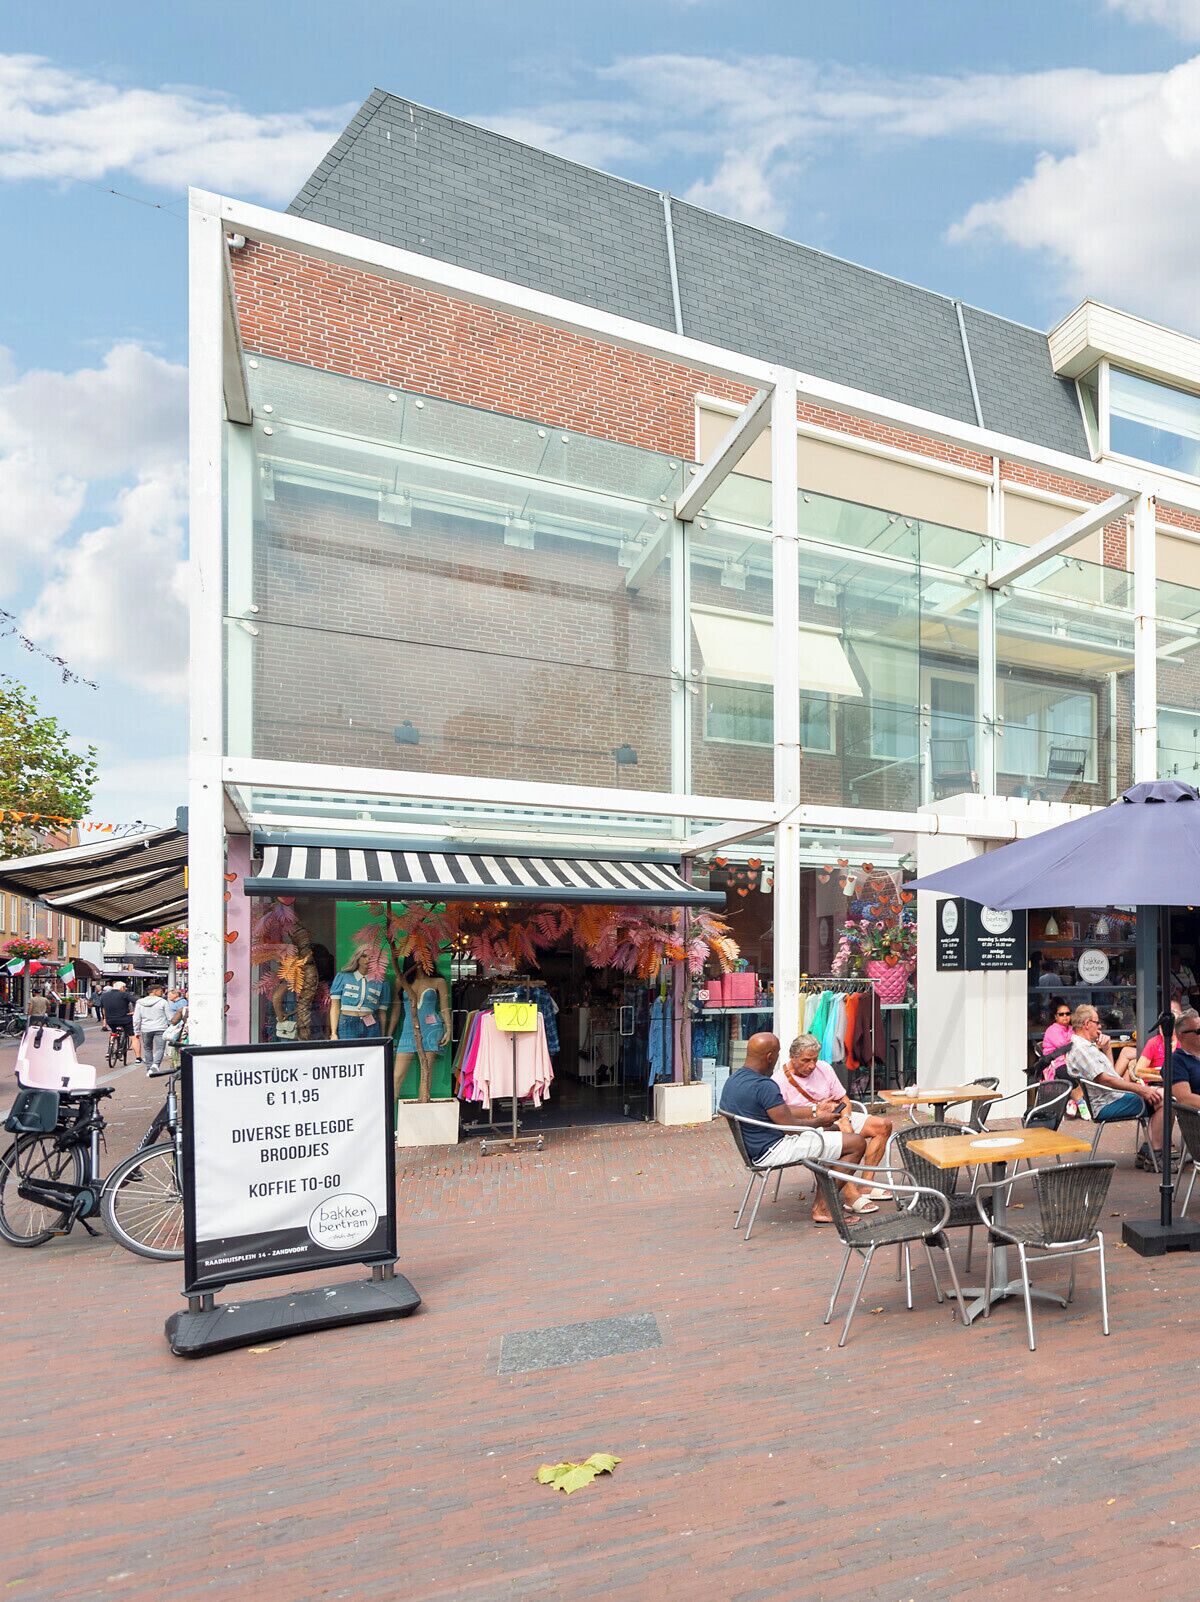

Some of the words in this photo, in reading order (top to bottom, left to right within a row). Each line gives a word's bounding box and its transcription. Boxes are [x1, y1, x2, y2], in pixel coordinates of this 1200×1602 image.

[1083, 957, 1104, 965] bakker
[506, 1004, 529, 1027] 20
[215, 1067, 299, 1088] FRÜHSTÜCK
[312, 1063, 365, 1081] ONTBIJT
[266, 1091, 275, 1106] €
[281, 1088, 320, 1105] 11,95
[232, 1124, 291, 1144] DIVERSE
[295, 1118, 354, 1138] BELEGDE
[260, 1142, 329, 1163] BROODJES
[248, 1179, 297, 1198] KOFFIE
[300, 1174, 341, 1192] TO-GO
[320, 1205, 368, 1221] bakker
[318, 1218, 368, 1233] bertram
[204, 1253, 257, 1267] RAADHUISPLEIN
[272, 1245, 309, 1256] ZANDVOORT
